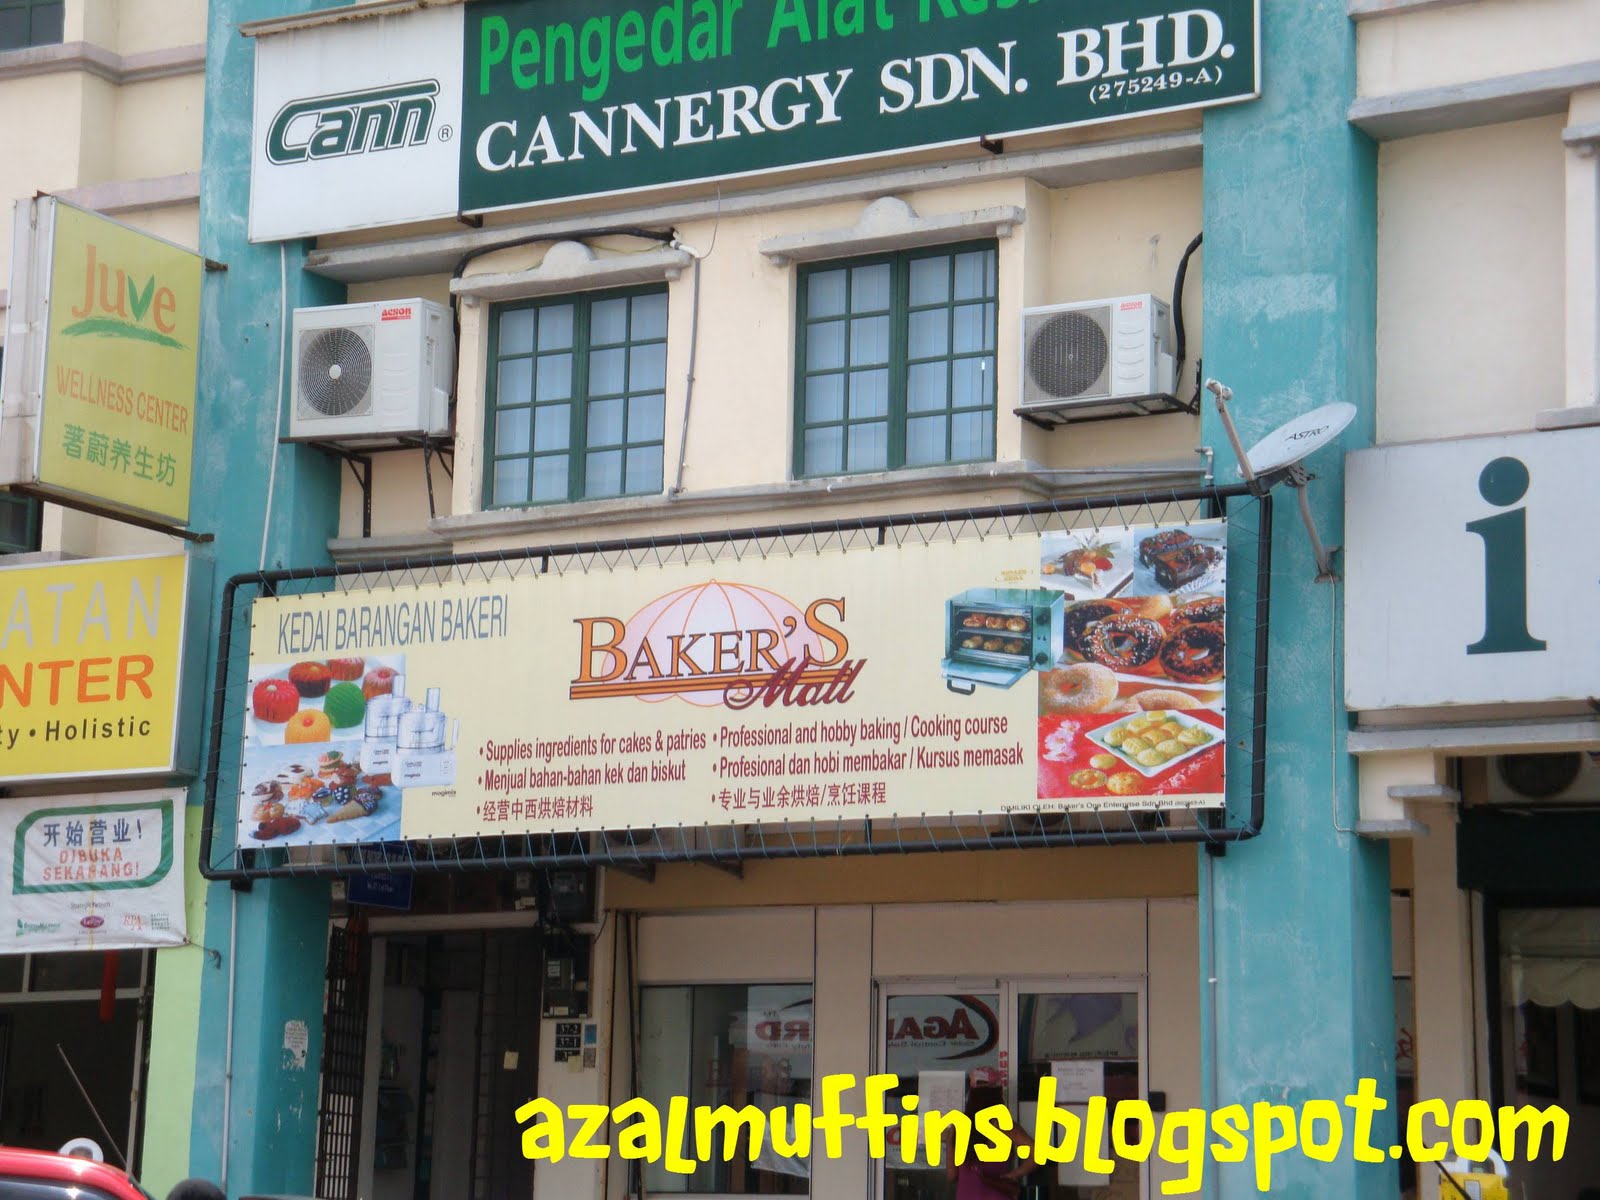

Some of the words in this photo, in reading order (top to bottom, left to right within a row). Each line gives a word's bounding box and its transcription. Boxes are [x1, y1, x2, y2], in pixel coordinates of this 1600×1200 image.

[480, 0, 743, 102] Pengedar
[476, 68, 853, 172] CANNERGY
[879, 40, 1028, 114] SDN.
[1057, 9, 1235, 86] BHD.
[1089, 65, 1223, 104] (275249-A)
[265, 78, 441, 166] Cann
[71, 243, 177, 334] Juve
[56, 364, 133, 417] WELLNESS
[136, 391, 188, 435] CENTER
[0, 575, 163, 649] ATAN
[278, 608, 330, 654] KEDAI
[335, 601, 437, 650] BARANGAN
[440, 593, 508, 642] BAKERI
[570, 596, 850, 684] BAKER'S
[0, 654, 154, 709] NTER
[45, 716, 151, 741] Holistic
[486, 738, 532, 766] Supplies
[535, 734, 597, 763] ingredients
[600, 733, 616, 754] for
[619, 731, 651, 753] cakes
[655, 730, 663, 751] &
[666, 728, 706, 756] patries
[720, 723, 792, 748] Professional
[795, 721, 817, 744] and
[820, 719, 857, 746] hobby
[860, 717, 901, 744] baking
[911, 714, 961, 742] Cooking
[965, 715, 1008, 736] course
[485, 767, 527, 795] Menjual
[529, 764, 601, 788] bahan-bahan
[604, 763, 624, 784] kek
[627, 761, 648, 783] dan
[651, 759, 686, 782] biskut
[719, 753, 786, 778] Profesional
[788, 751, 810, 775] dan
[814, 750, 840, 774] hobi
[843, 747, 907, 773] membakar
[917, 746, 960, 769] Kursus
[963, 742, 1023, 767] memasak
[483, 795, 593, 822] 经营中西烘焙材料
[718, 781, 887, 811] 专业与业余烘焙/烹饪课程
